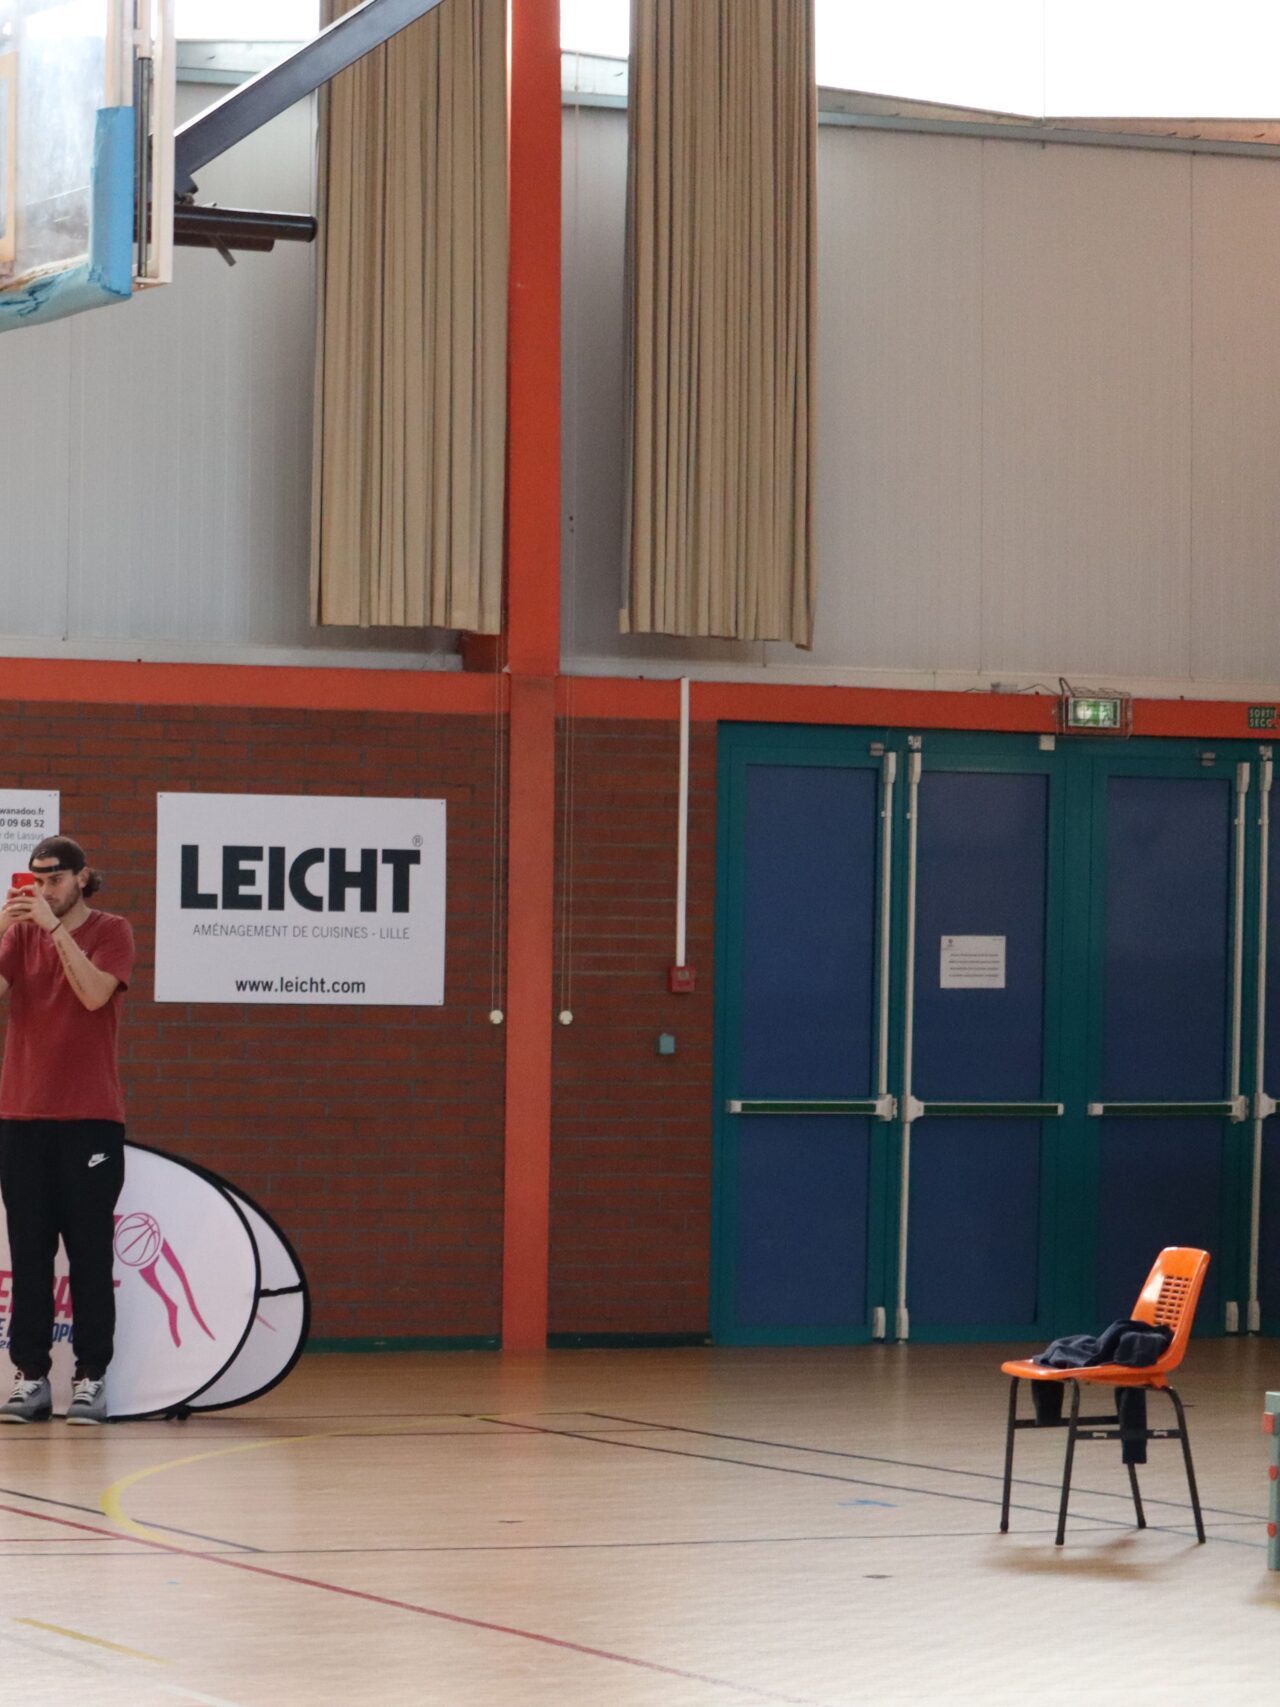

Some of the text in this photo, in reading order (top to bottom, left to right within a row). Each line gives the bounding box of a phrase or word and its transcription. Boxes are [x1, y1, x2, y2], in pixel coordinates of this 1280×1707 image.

[7, 818, 19, 828] 09
[20, 818, 32, 828] 68
[34, 819, 45, 828] 52
[4, 831, 15, 840] de
[180, 844, 421, 913] LEICHT
[192, 923, 288, 938] AMÉNAGEMENT
[292, 925, 308, 938] DE
[312, 926, 368, 939] CUISINES
[379, 927, 410, 940] LILLE
[235, 976, 366, 994] www.leicht.com
